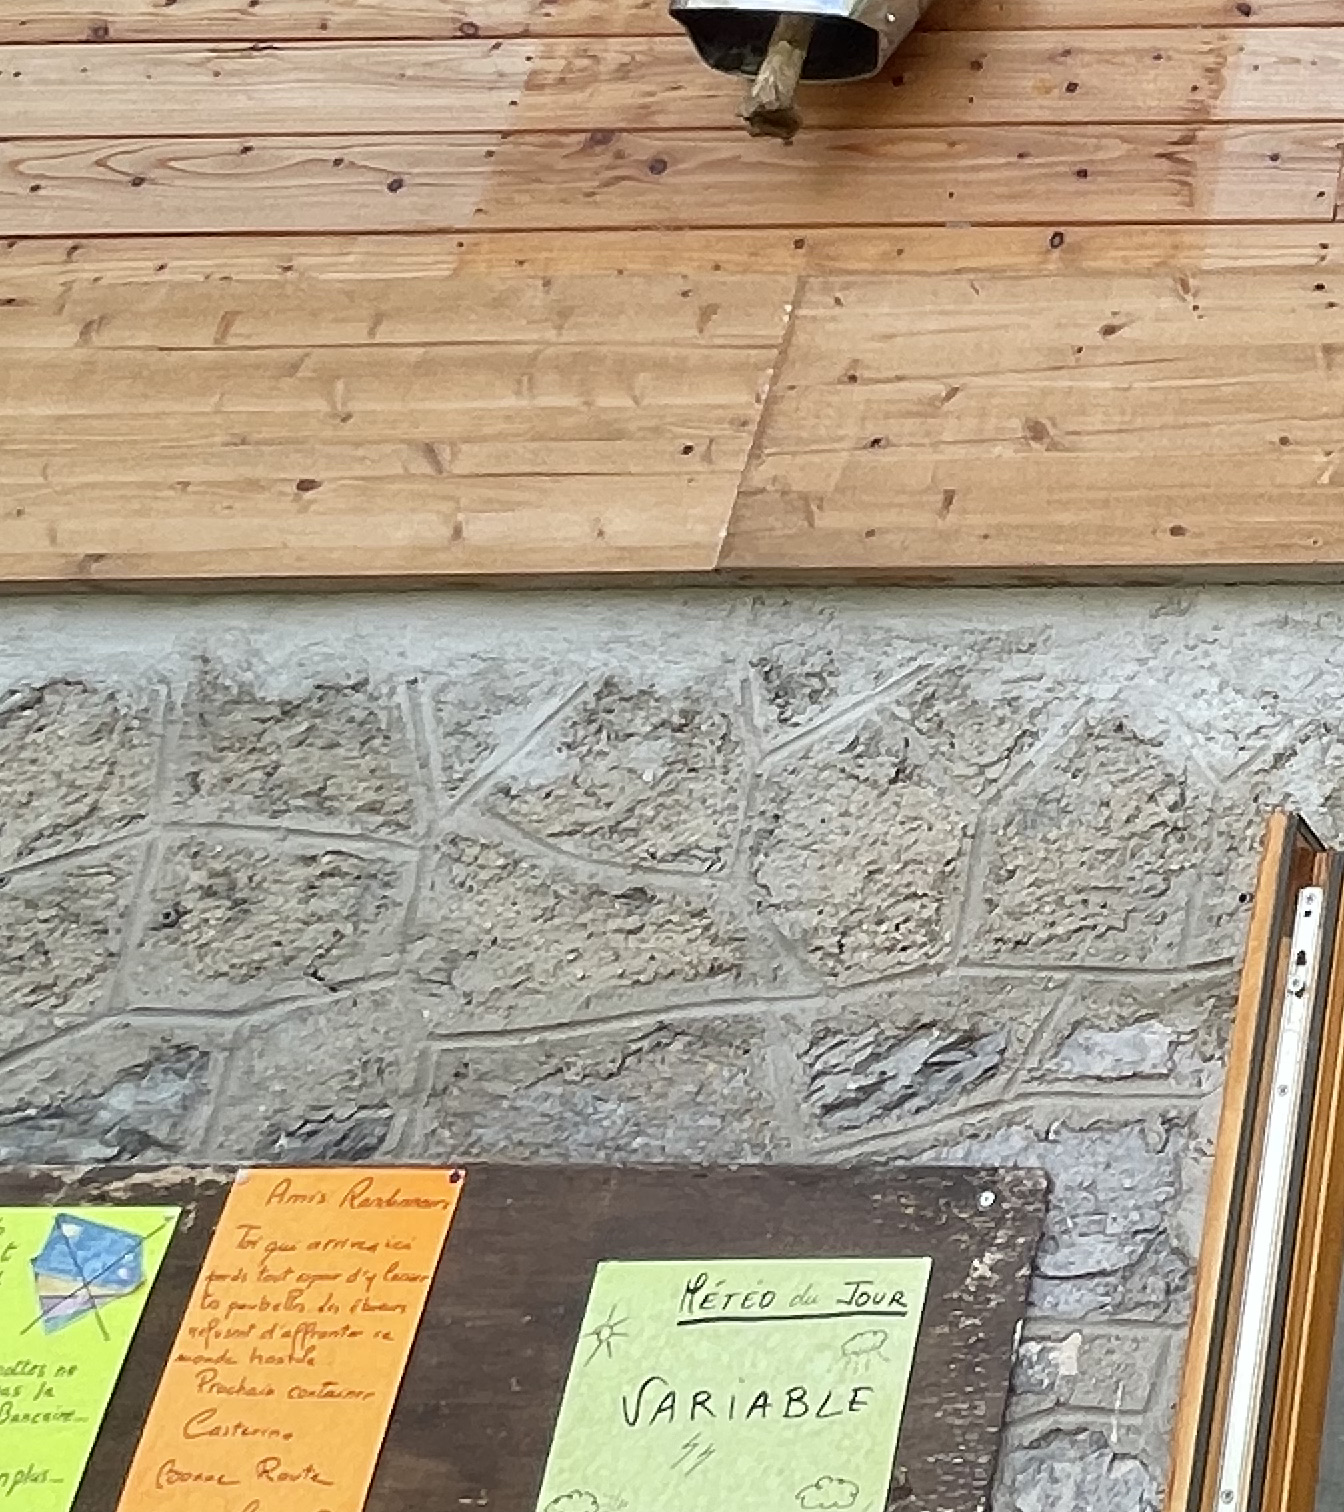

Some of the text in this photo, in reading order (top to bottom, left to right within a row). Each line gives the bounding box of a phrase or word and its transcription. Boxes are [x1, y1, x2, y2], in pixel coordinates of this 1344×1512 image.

[265, 1178, 328, 1207] Amis
[259, 1239, 298, 1267] qui
[621, 1375, 874, 1427] VARIABLE
[255, 1455, 334, 1486] Route
